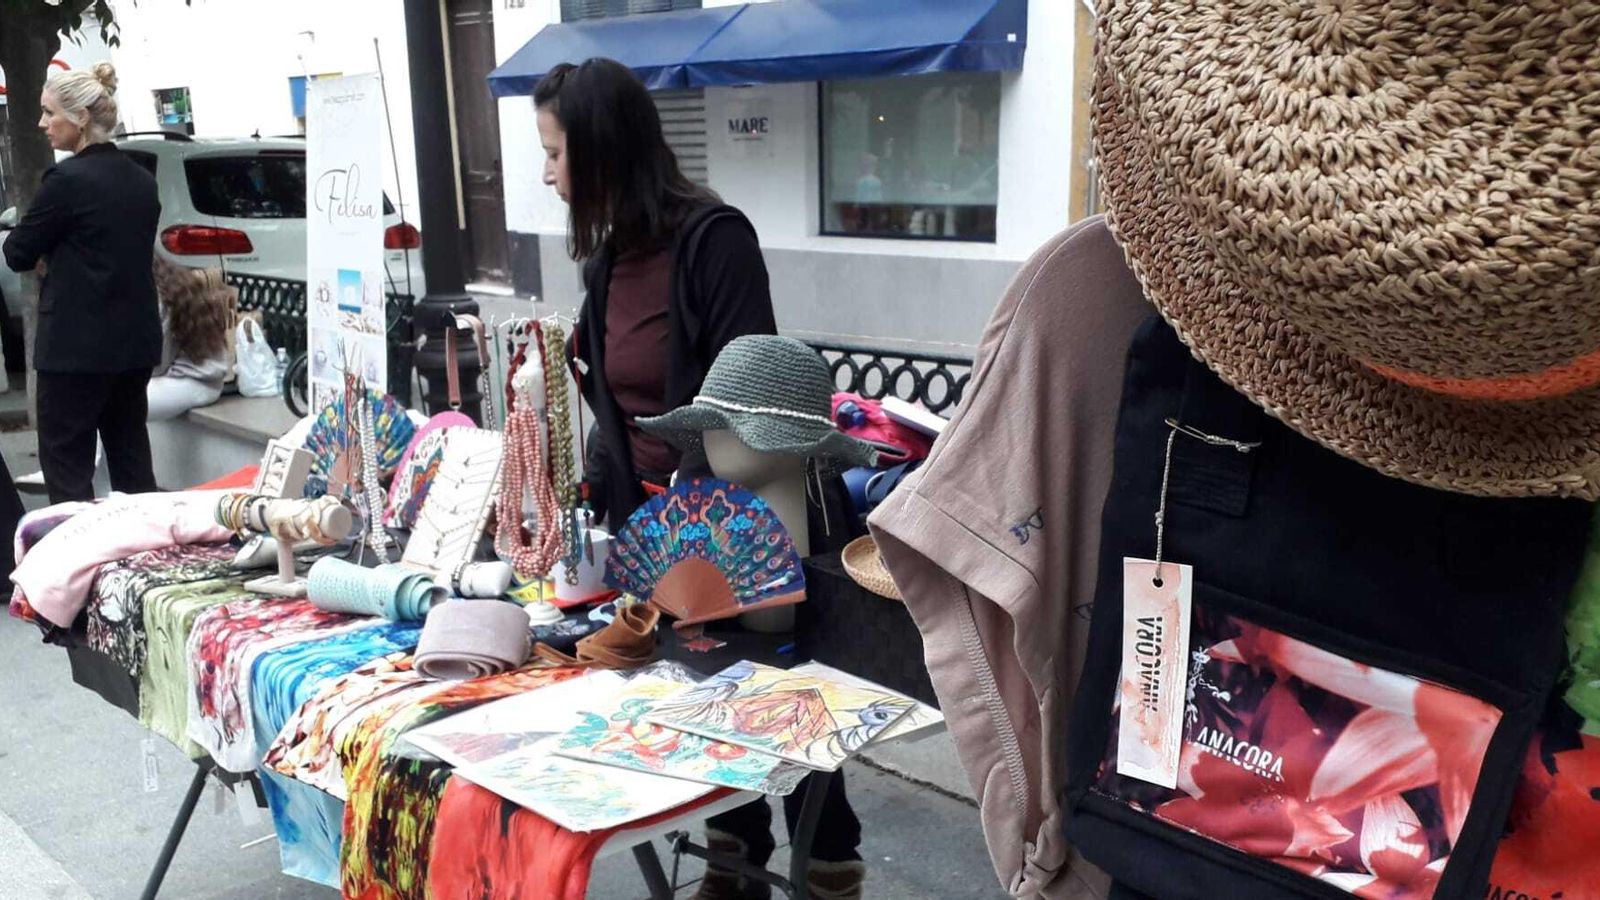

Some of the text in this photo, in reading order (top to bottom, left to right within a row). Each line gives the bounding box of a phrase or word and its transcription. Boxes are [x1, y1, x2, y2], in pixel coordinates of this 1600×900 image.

[728, 117, 769, 134] MARE
[314, 162, 379, 224] Felisa
[1135, 617, 1163, 712] ANACORA
[1193, 726, 1285, 782] ANACORA
